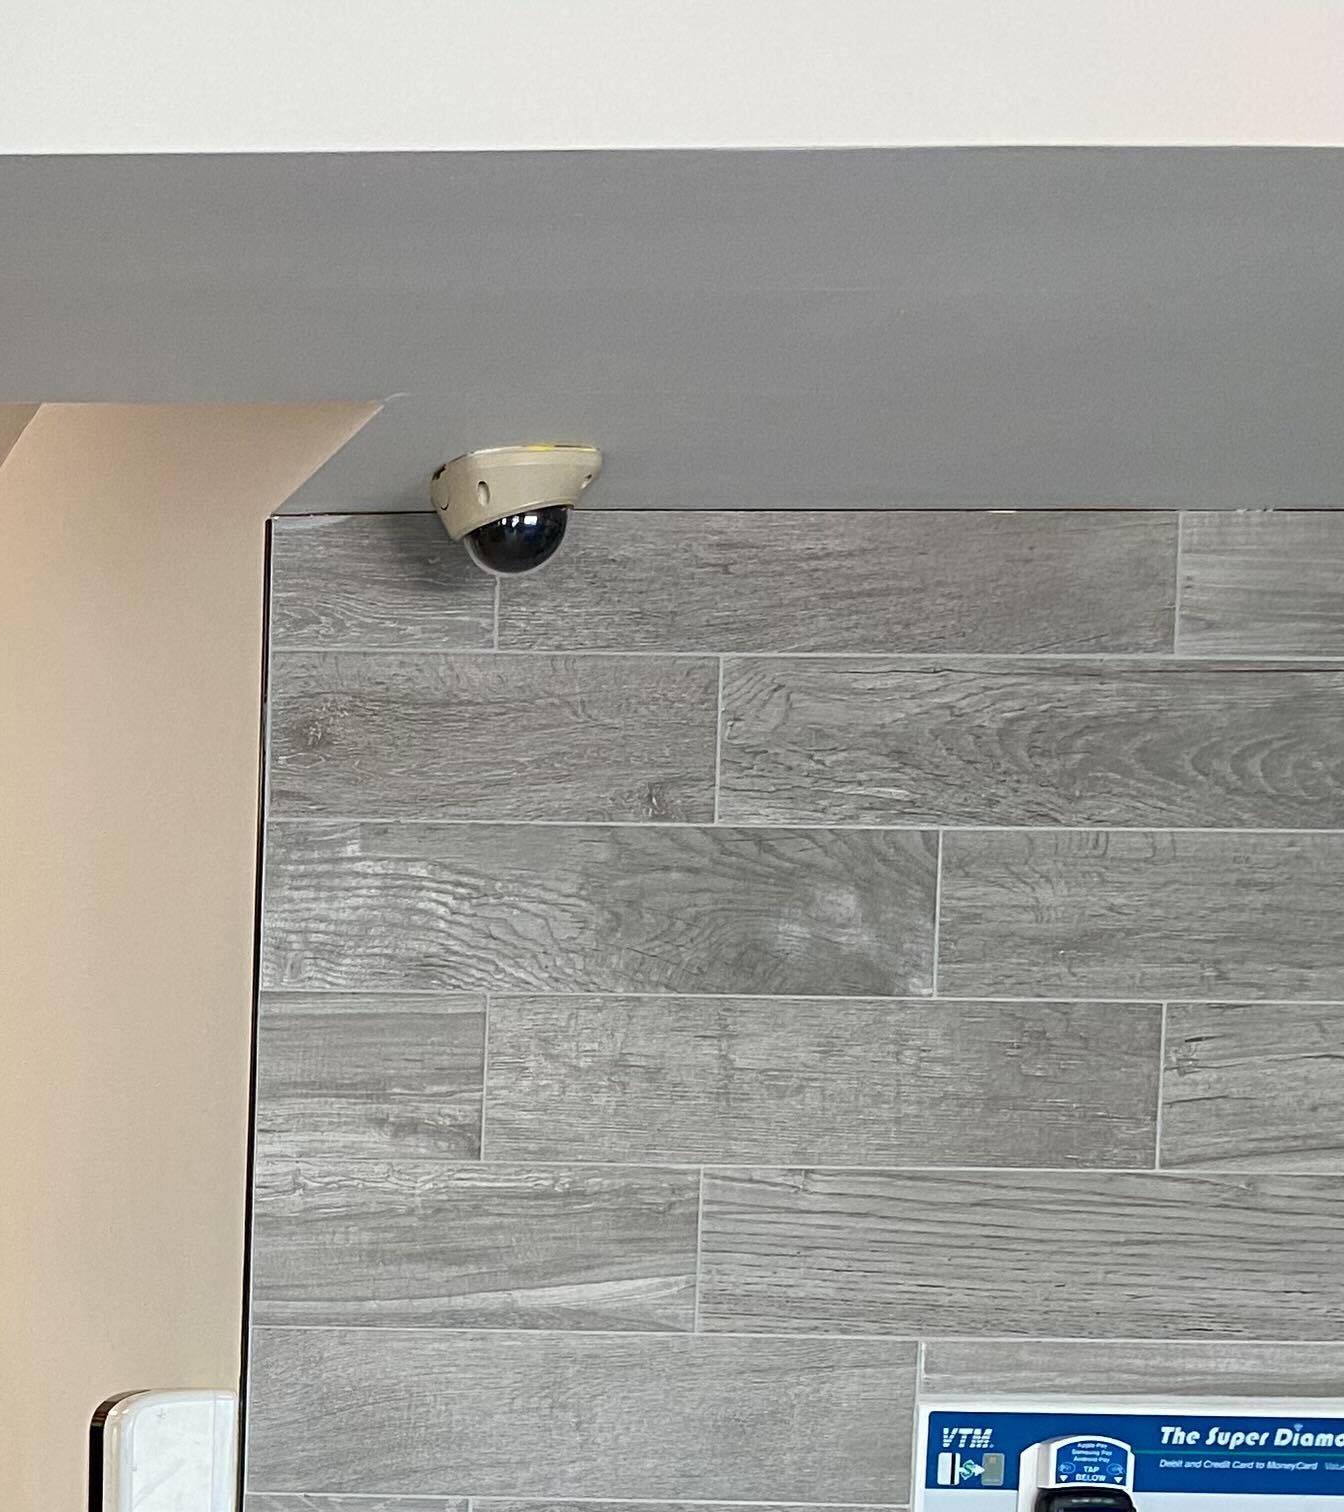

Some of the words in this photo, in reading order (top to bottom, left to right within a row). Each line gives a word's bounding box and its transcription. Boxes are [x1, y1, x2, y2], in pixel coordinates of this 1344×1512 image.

[942, 1427, 993, 1448] VTM
[1161, 1427, 1200, 1445] The
[1205, 1427, 1269, 1450] Super
[1160, 1459, 1183, 1468] Debit
[1184, 1460, 1201, 1469] and
[1204, 1460, 1231, 1469] Credit
[1232, 1461, 1254, 1469] Card
[1267, 1461, 1318, 1471] MoneyCard
[1076, 1473, 1106, 1482] BELOW
